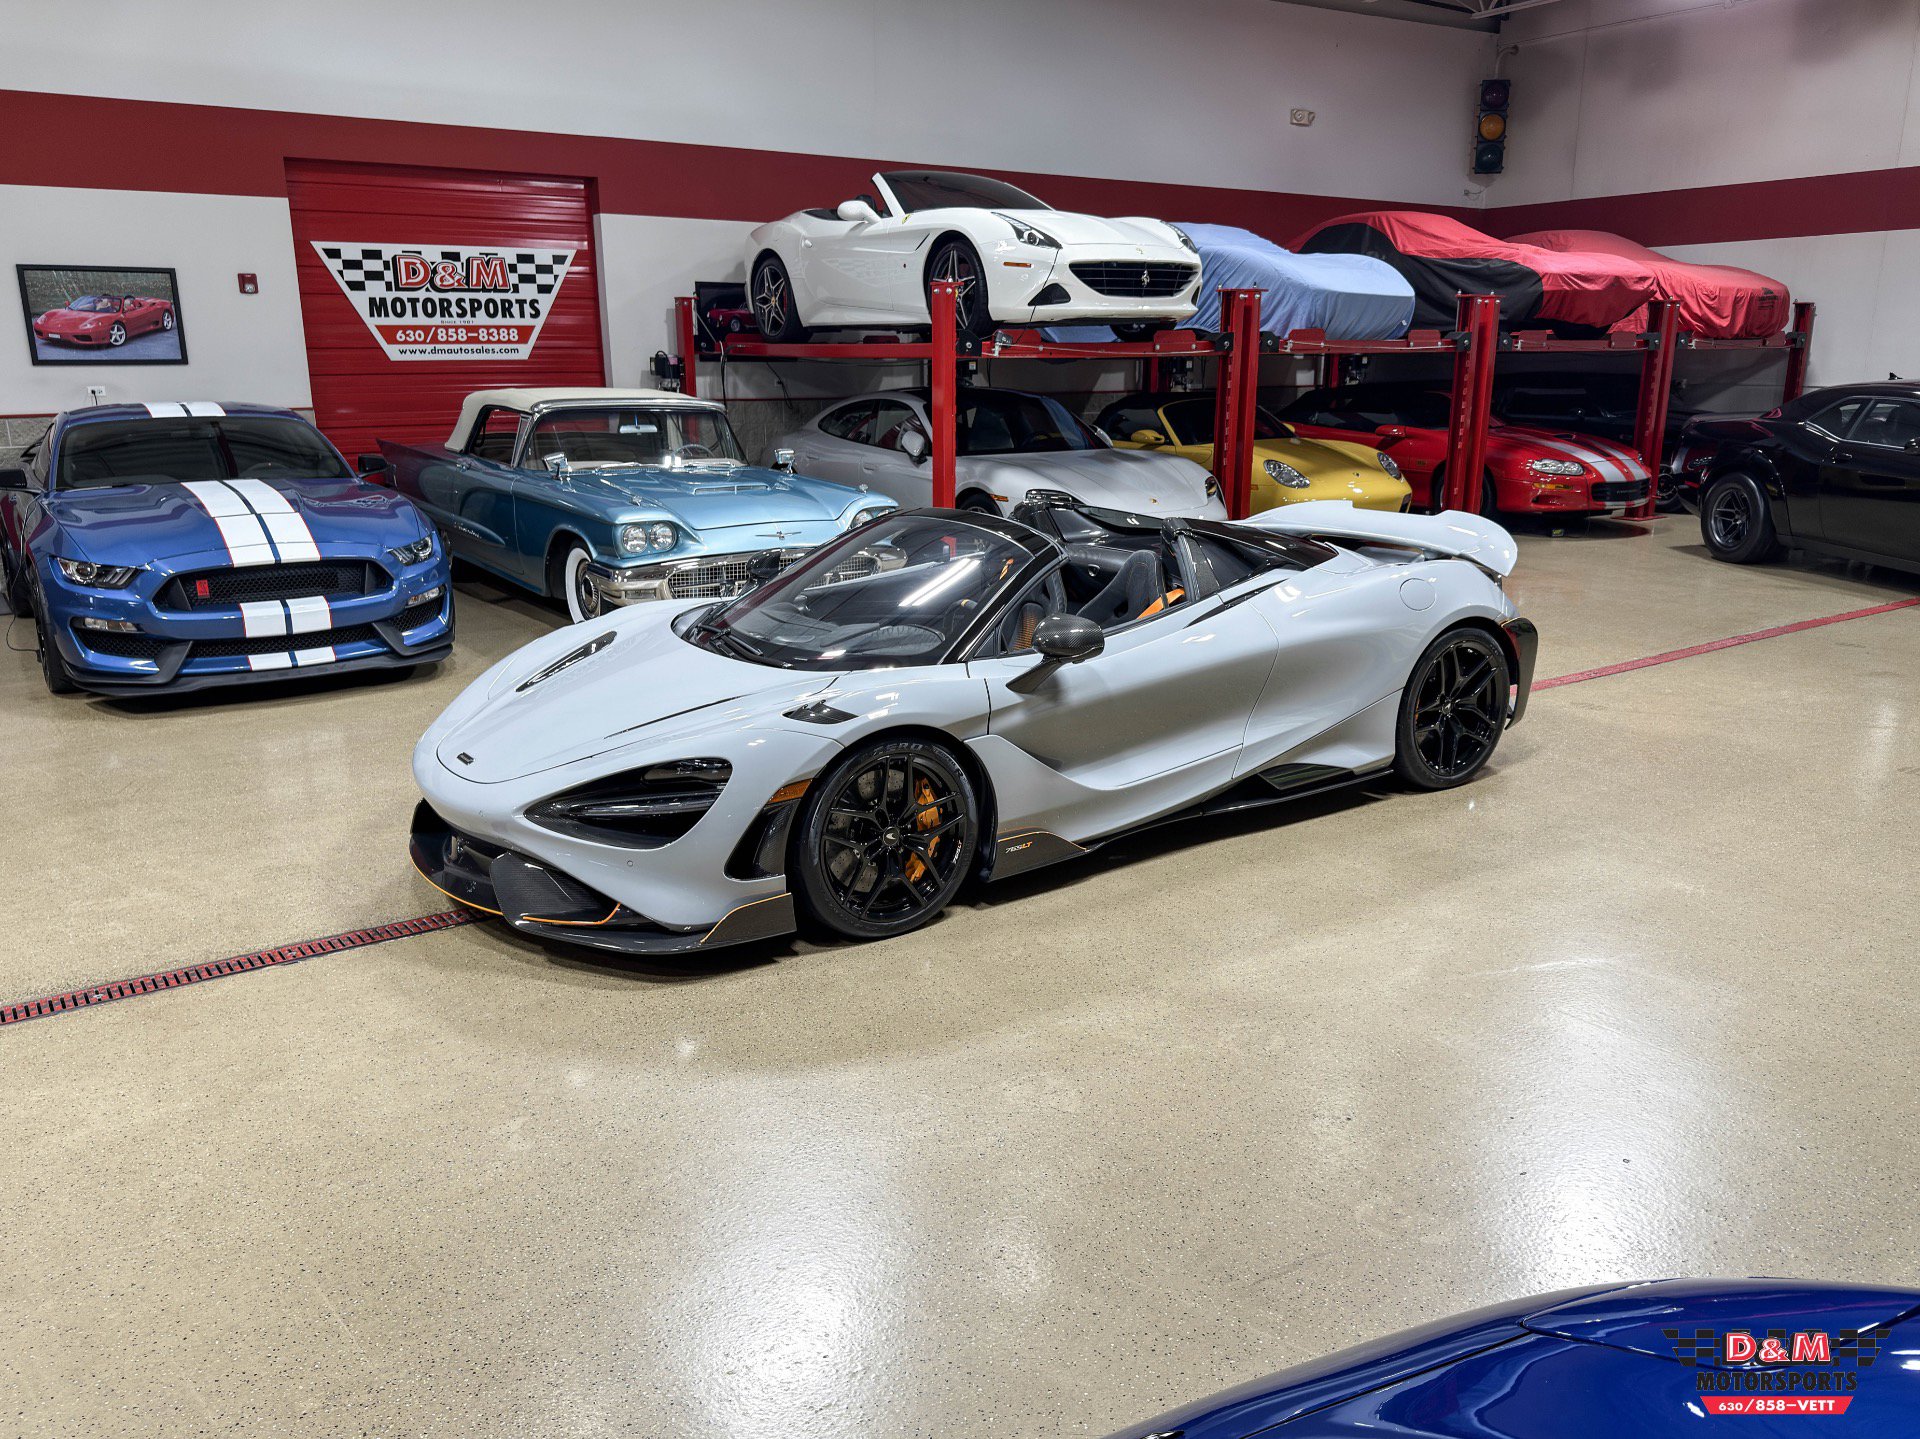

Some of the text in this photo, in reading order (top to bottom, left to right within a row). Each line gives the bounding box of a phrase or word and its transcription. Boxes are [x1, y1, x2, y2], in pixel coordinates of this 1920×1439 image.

[394, 254, 511, 292] D&M
[368, 297, 541, 319] MOTORSPORTS
[396, 326, 519, 343] 630/858-8388
[398, 345, 519, 355] www.dmautosales.com
